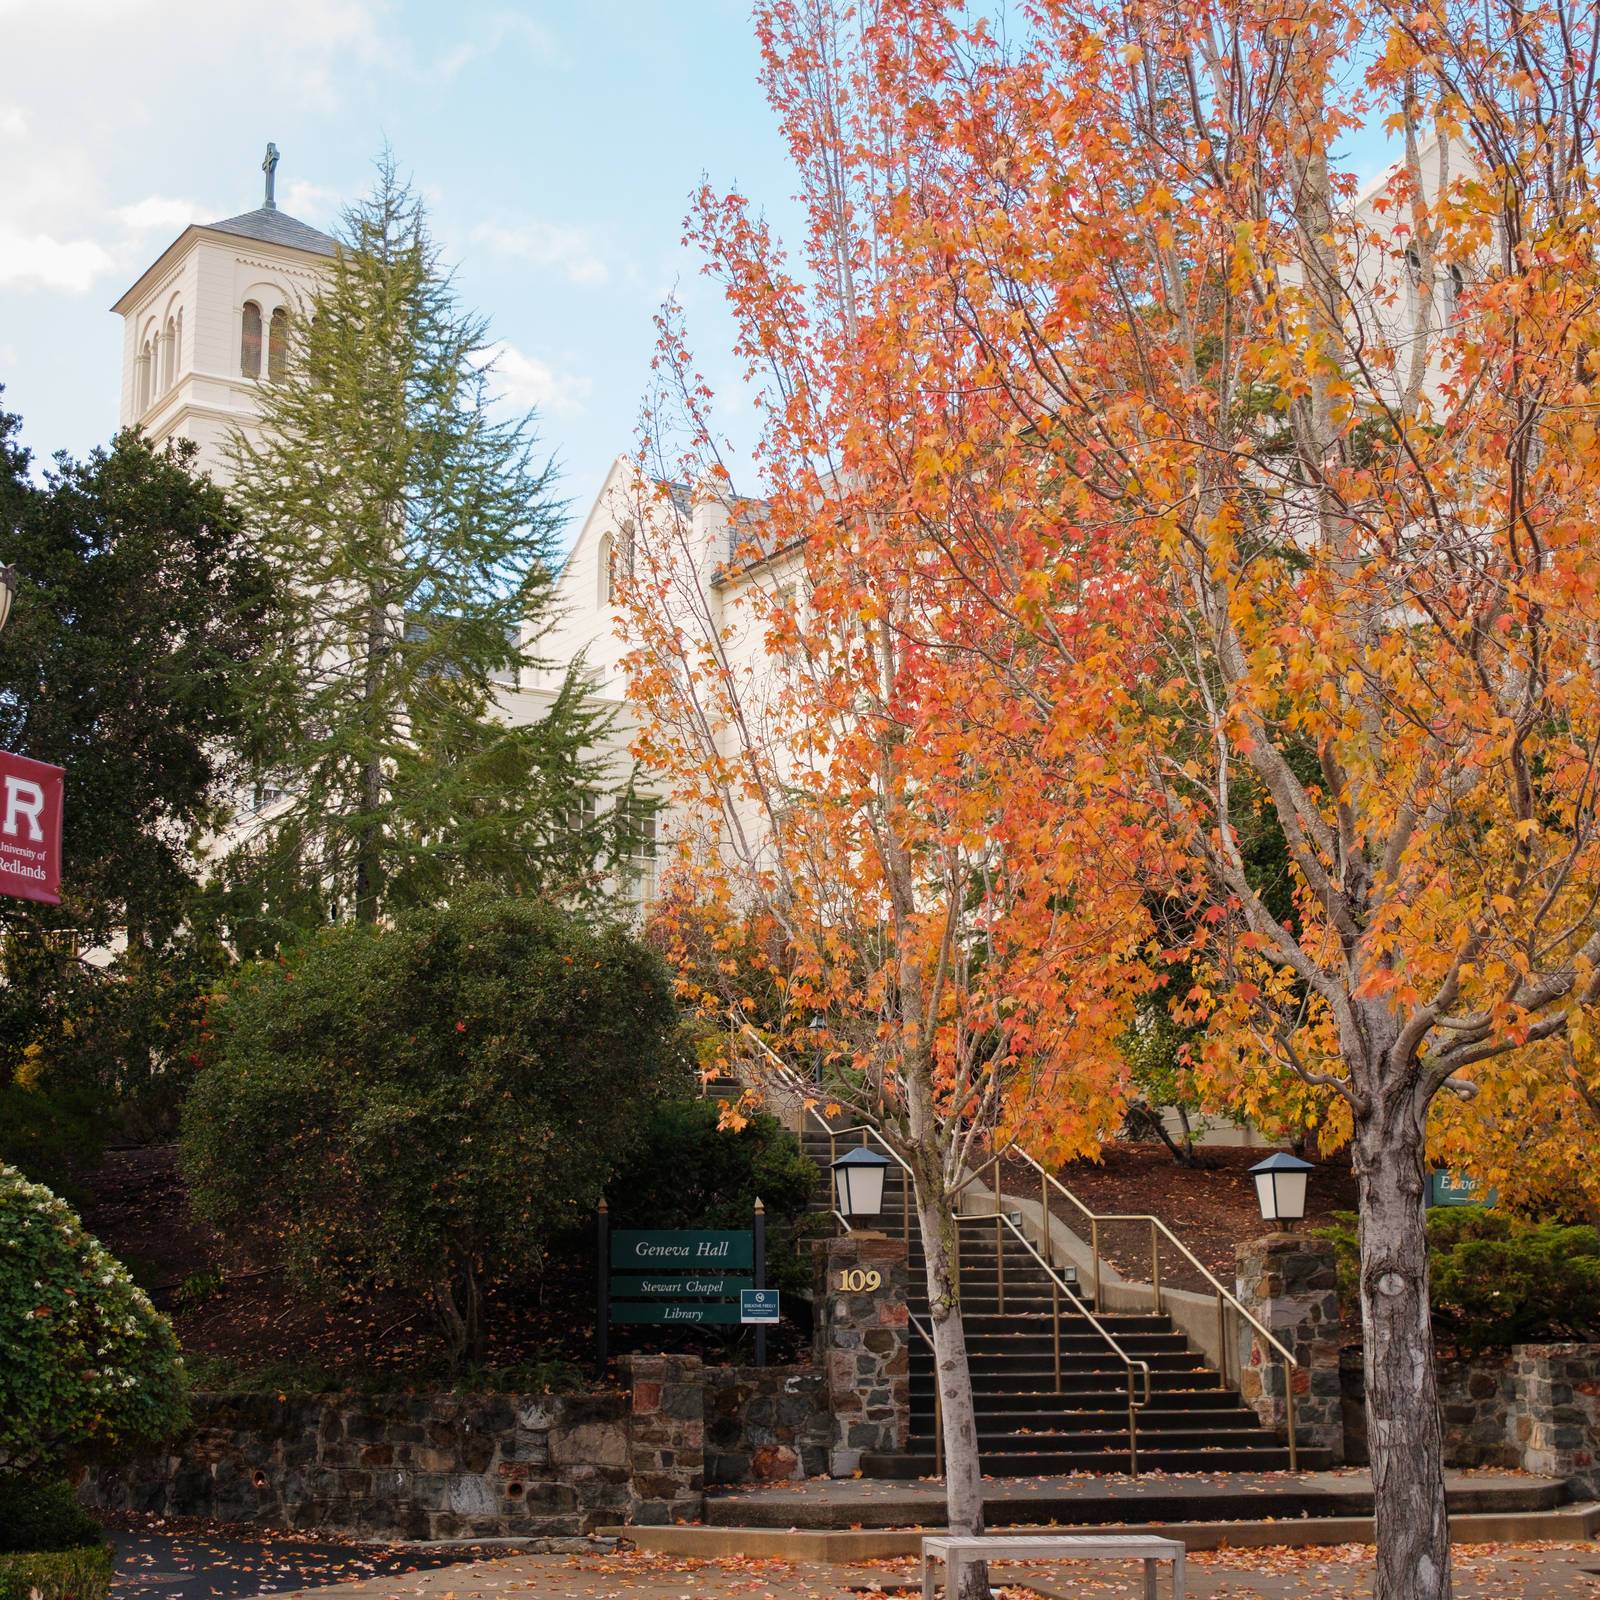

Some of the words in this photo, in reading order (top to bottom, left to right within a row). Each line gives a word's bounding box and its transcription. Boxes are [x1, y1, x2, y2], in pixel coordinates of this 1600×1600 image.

[3, 775, 44, 842] R
[37, 851, 47, 861] of
[635, 1241, 690, 1257] Geneva
[696, 1241, 729, 1257] Hall
[641, 1281, 681, 1293] Stewart
[686, 1280, 724, 1296] Chapel
[839, 1269, 881, 1292] 109
[664, 1307, 704, 1322] Library
